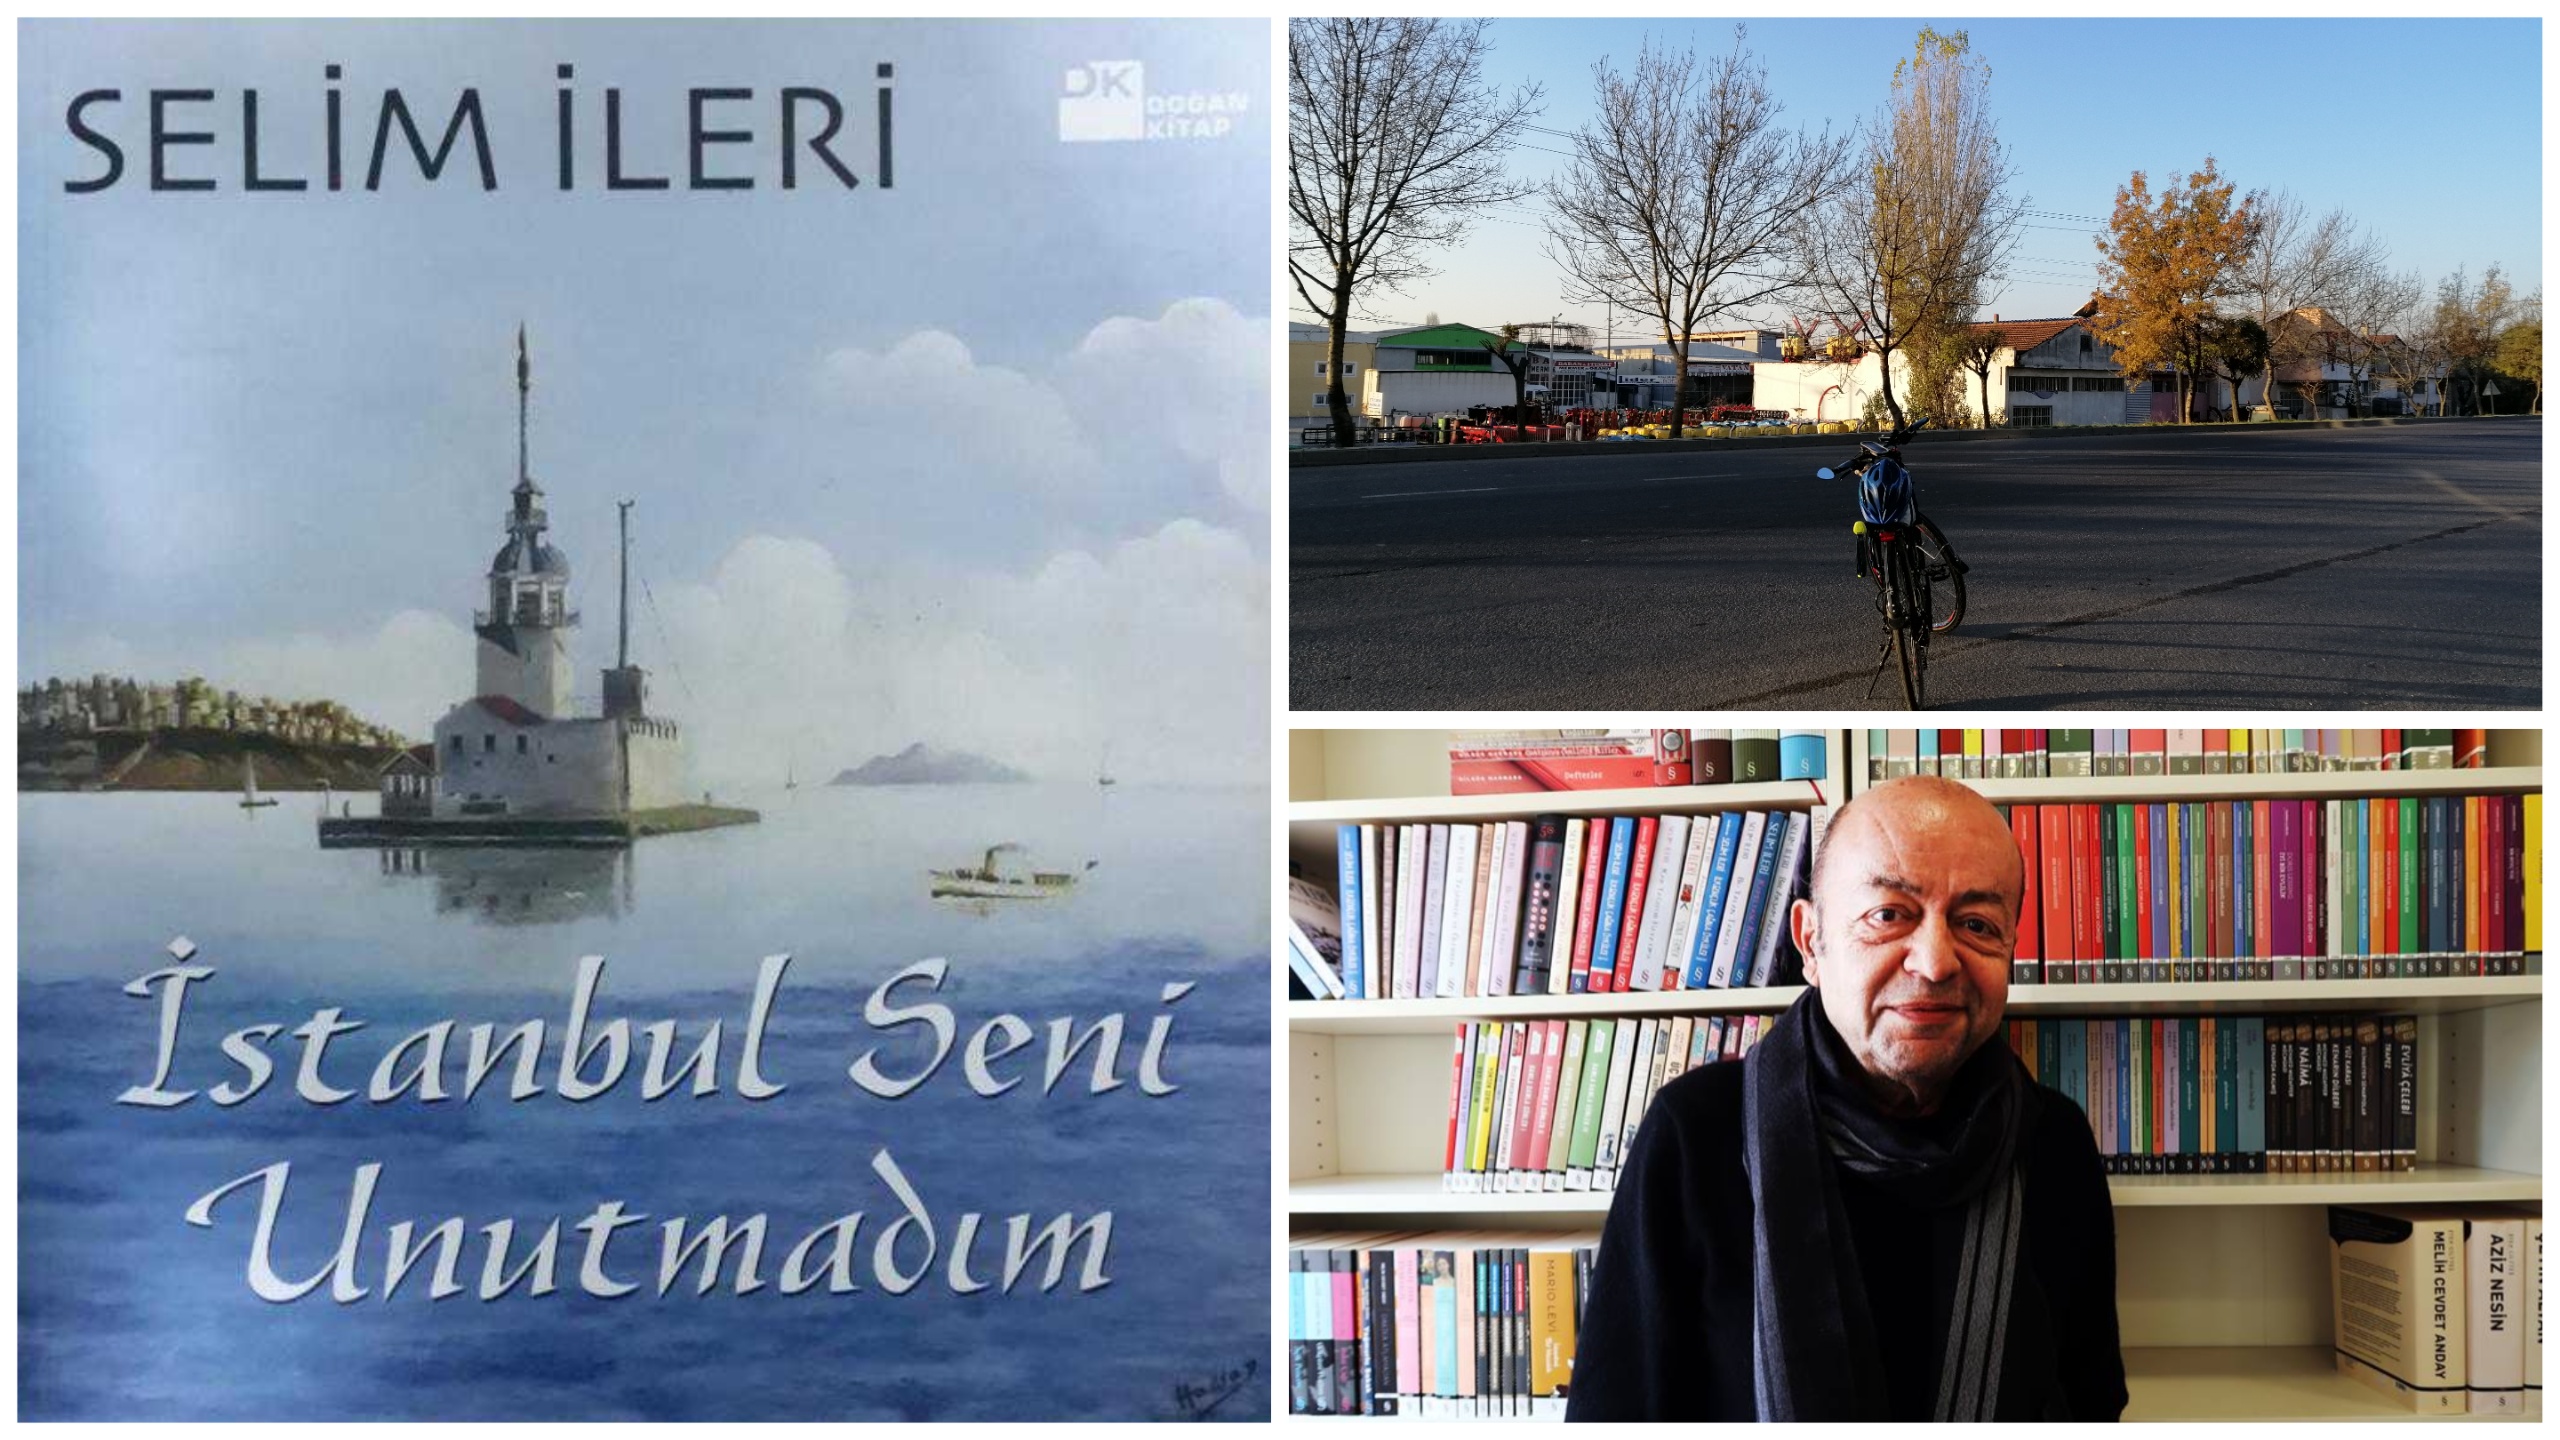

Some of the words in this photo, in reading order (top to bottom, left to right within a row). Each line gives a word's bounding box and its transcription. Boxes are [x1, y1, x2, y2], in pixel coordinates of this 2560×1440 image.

[63, 64, 498, 194] SELİM
[556, 62, 894, 192] İLERİ
[115, 935, 792, 1107] İstanbul
[847, 957, 1197, 1100] Seni
[2384, 1043, 2392, 1069] TRAPEZ
[2398, 1080, 2412, 1115] ÇELEBİ
[185, 1147, 1116, 1306] Unutmadım
[2434, 1231, 2447, 1273] MELİH
[2489, 1234, 2507, 1274] AZİZ
[2434, 1277, 2446, 1330] CEVDET
[2490, 1278, 2508, 1331] NESİN
[2434, 1333, 2446, 1379] ANDAY
